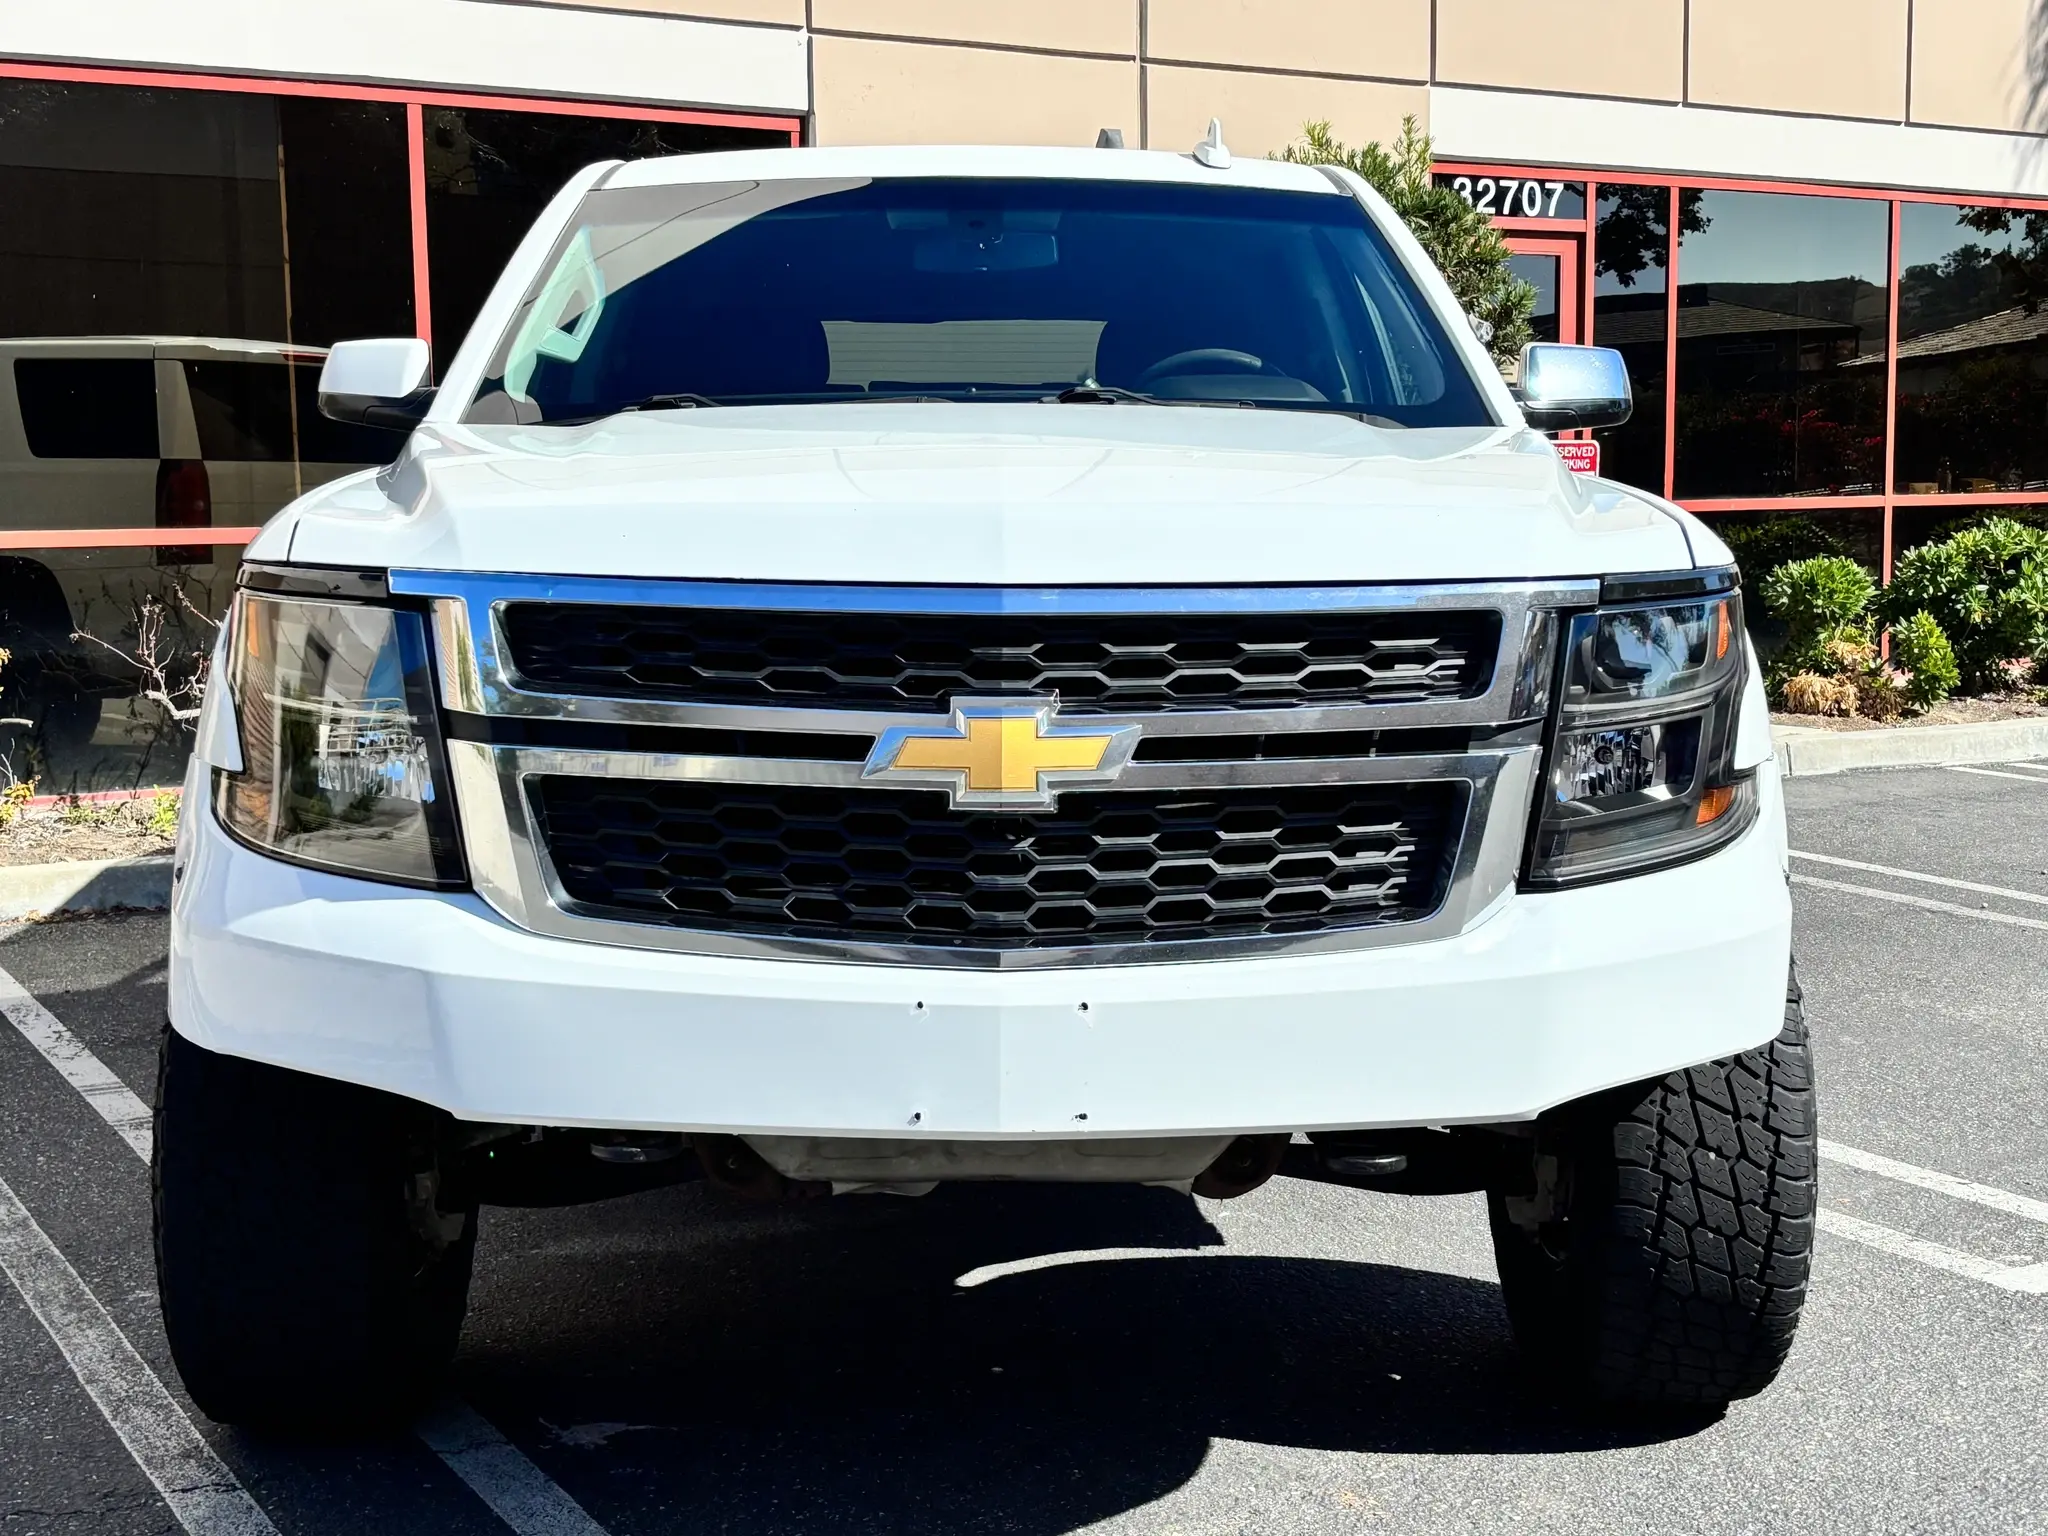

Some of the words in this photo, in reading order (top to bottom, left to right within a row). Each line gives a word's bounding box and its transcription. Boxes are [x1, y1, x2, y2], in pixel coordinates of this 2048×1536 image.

[1453, 176, 1565, 217] 32707
[1555, 446, 1595, 457] SERVED
[1563, 458, 1590, 470] RKING
